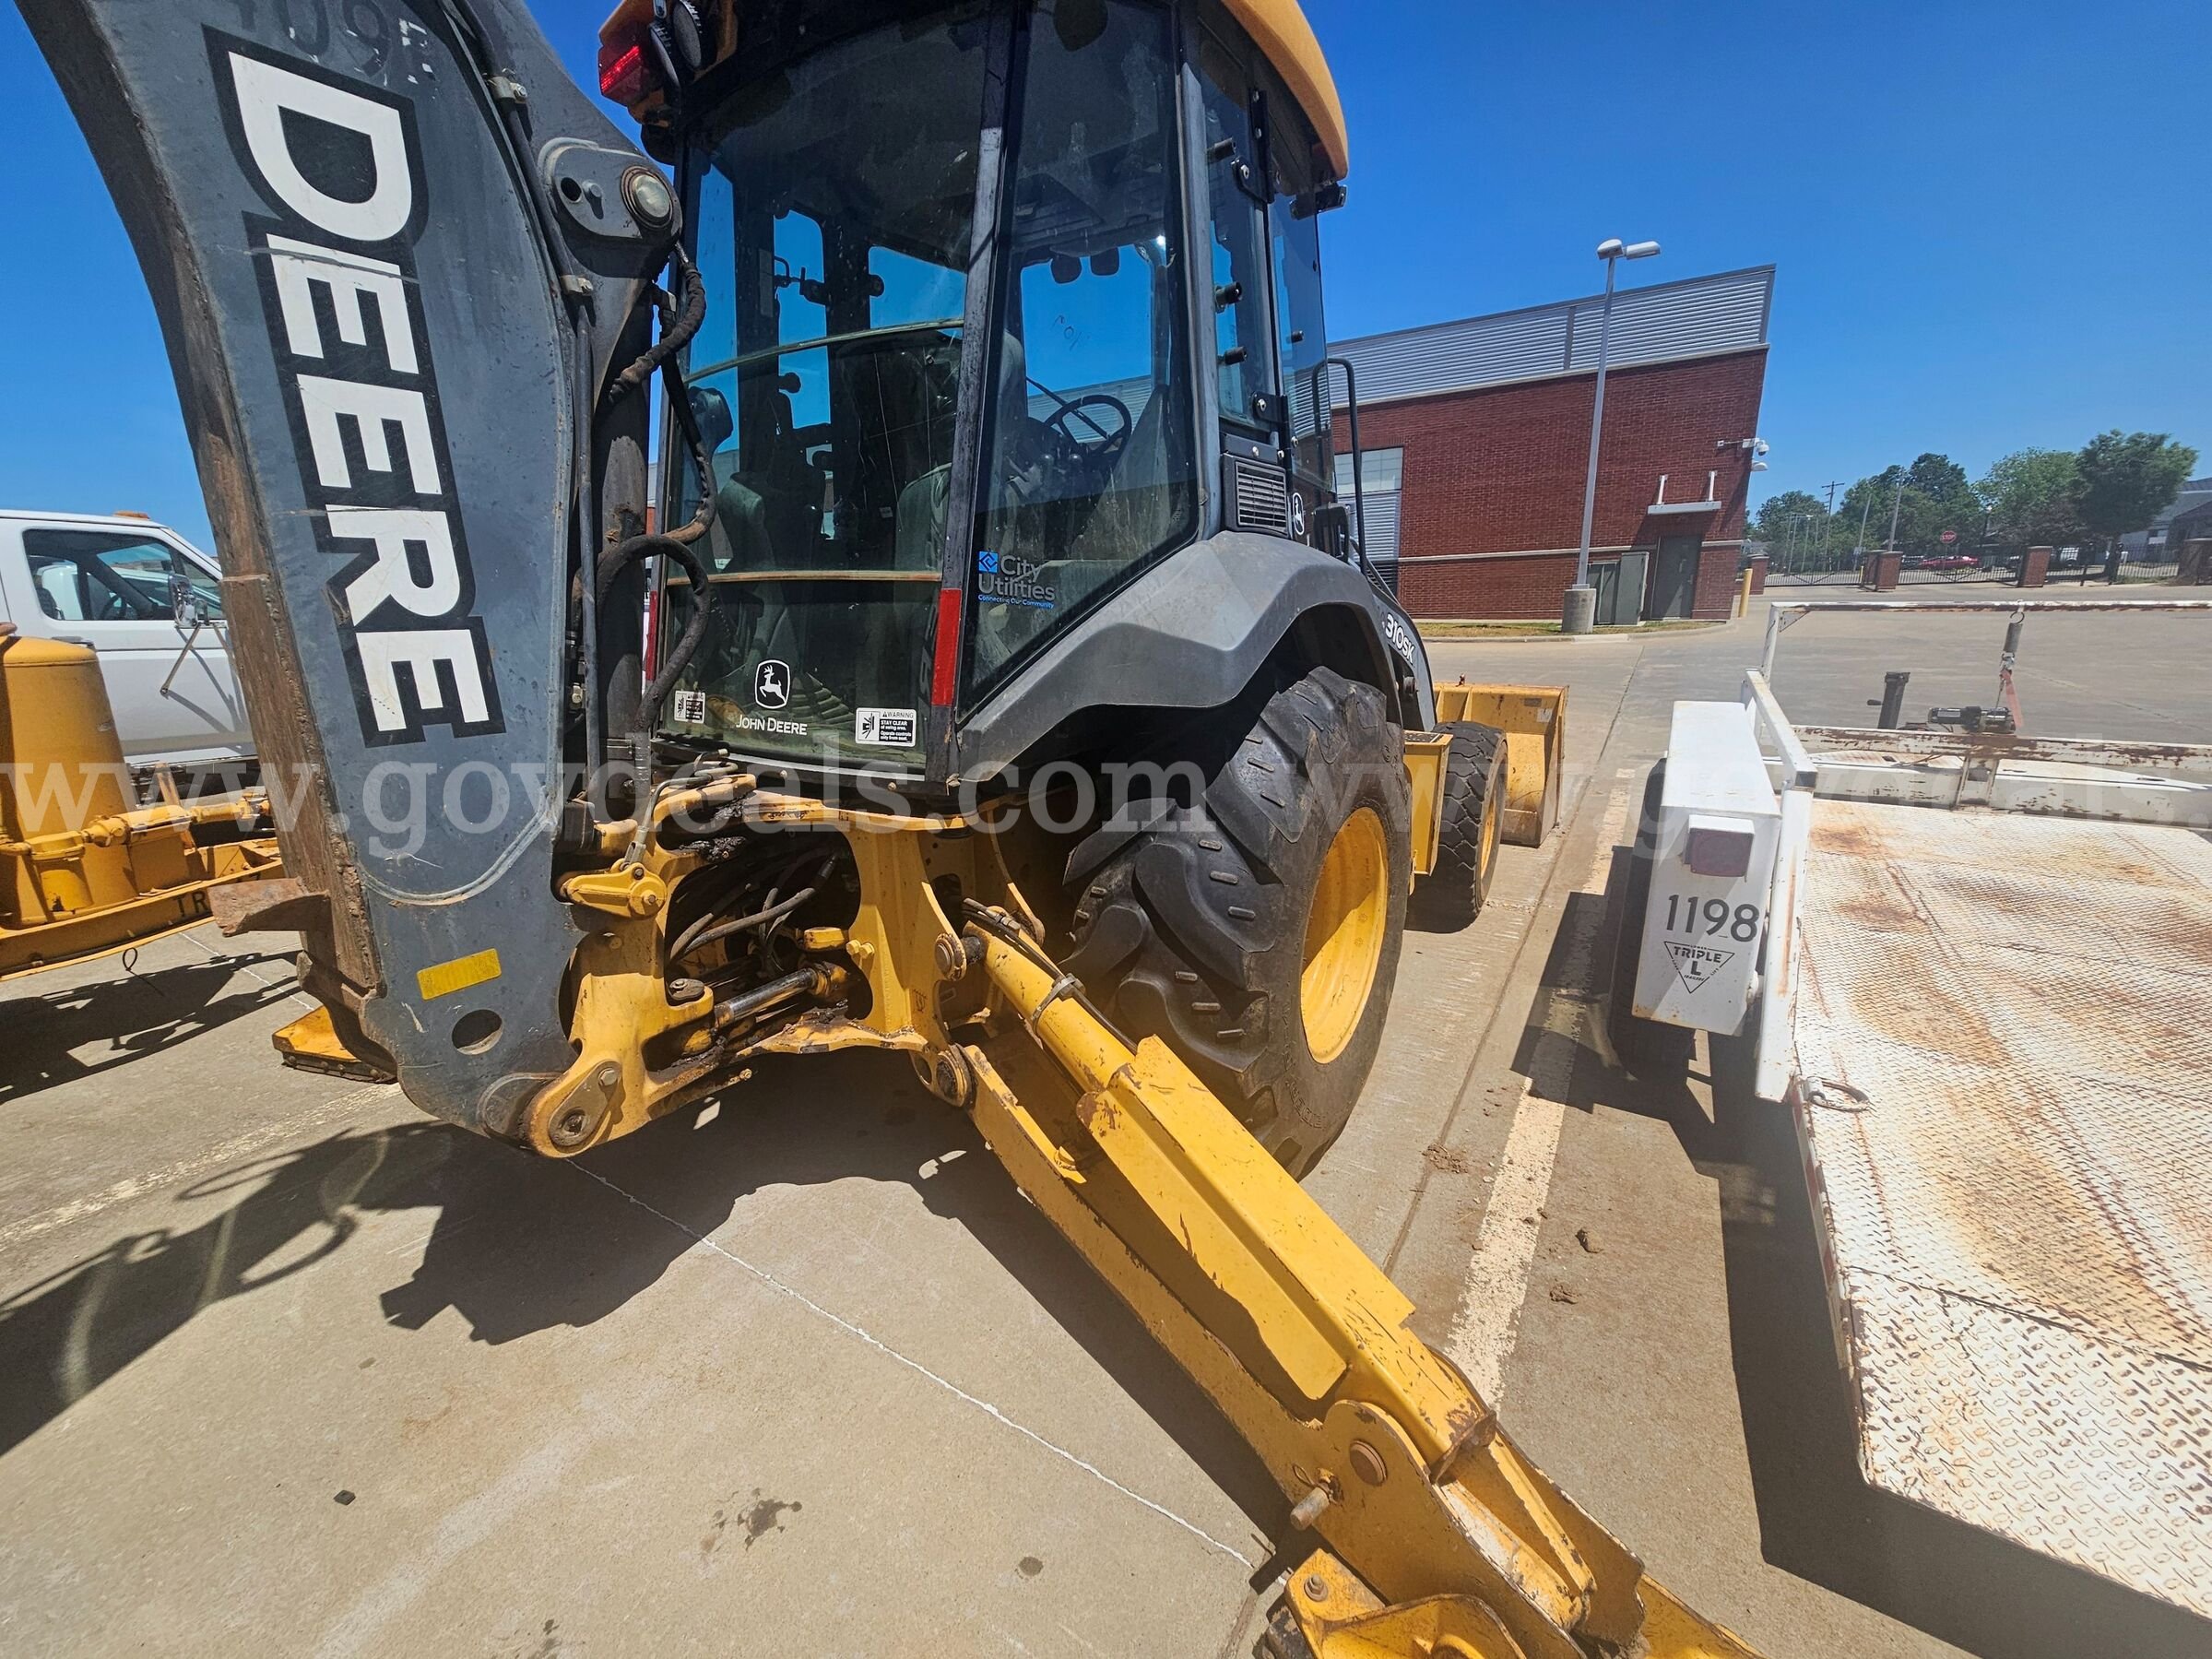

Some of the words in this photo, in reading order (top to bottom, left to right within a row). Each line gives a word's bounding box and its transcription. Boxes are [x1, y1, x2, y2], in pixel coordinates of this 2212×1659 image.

[227, 50, 491, 733] DEERE
[1000, 554, 1042, 583] City
[978, 573, 1056, 601] Utilities
[1385, 613, 1415, 664] 310SK
[735, 714, 765, 731] JOHN
[767, 717, 808, 736] DEERE
[1666, 895, 1760, 942] 1198
[1674, 946, 1722, 963] TRIPLE
[1690, 960, 1702, 976] L
